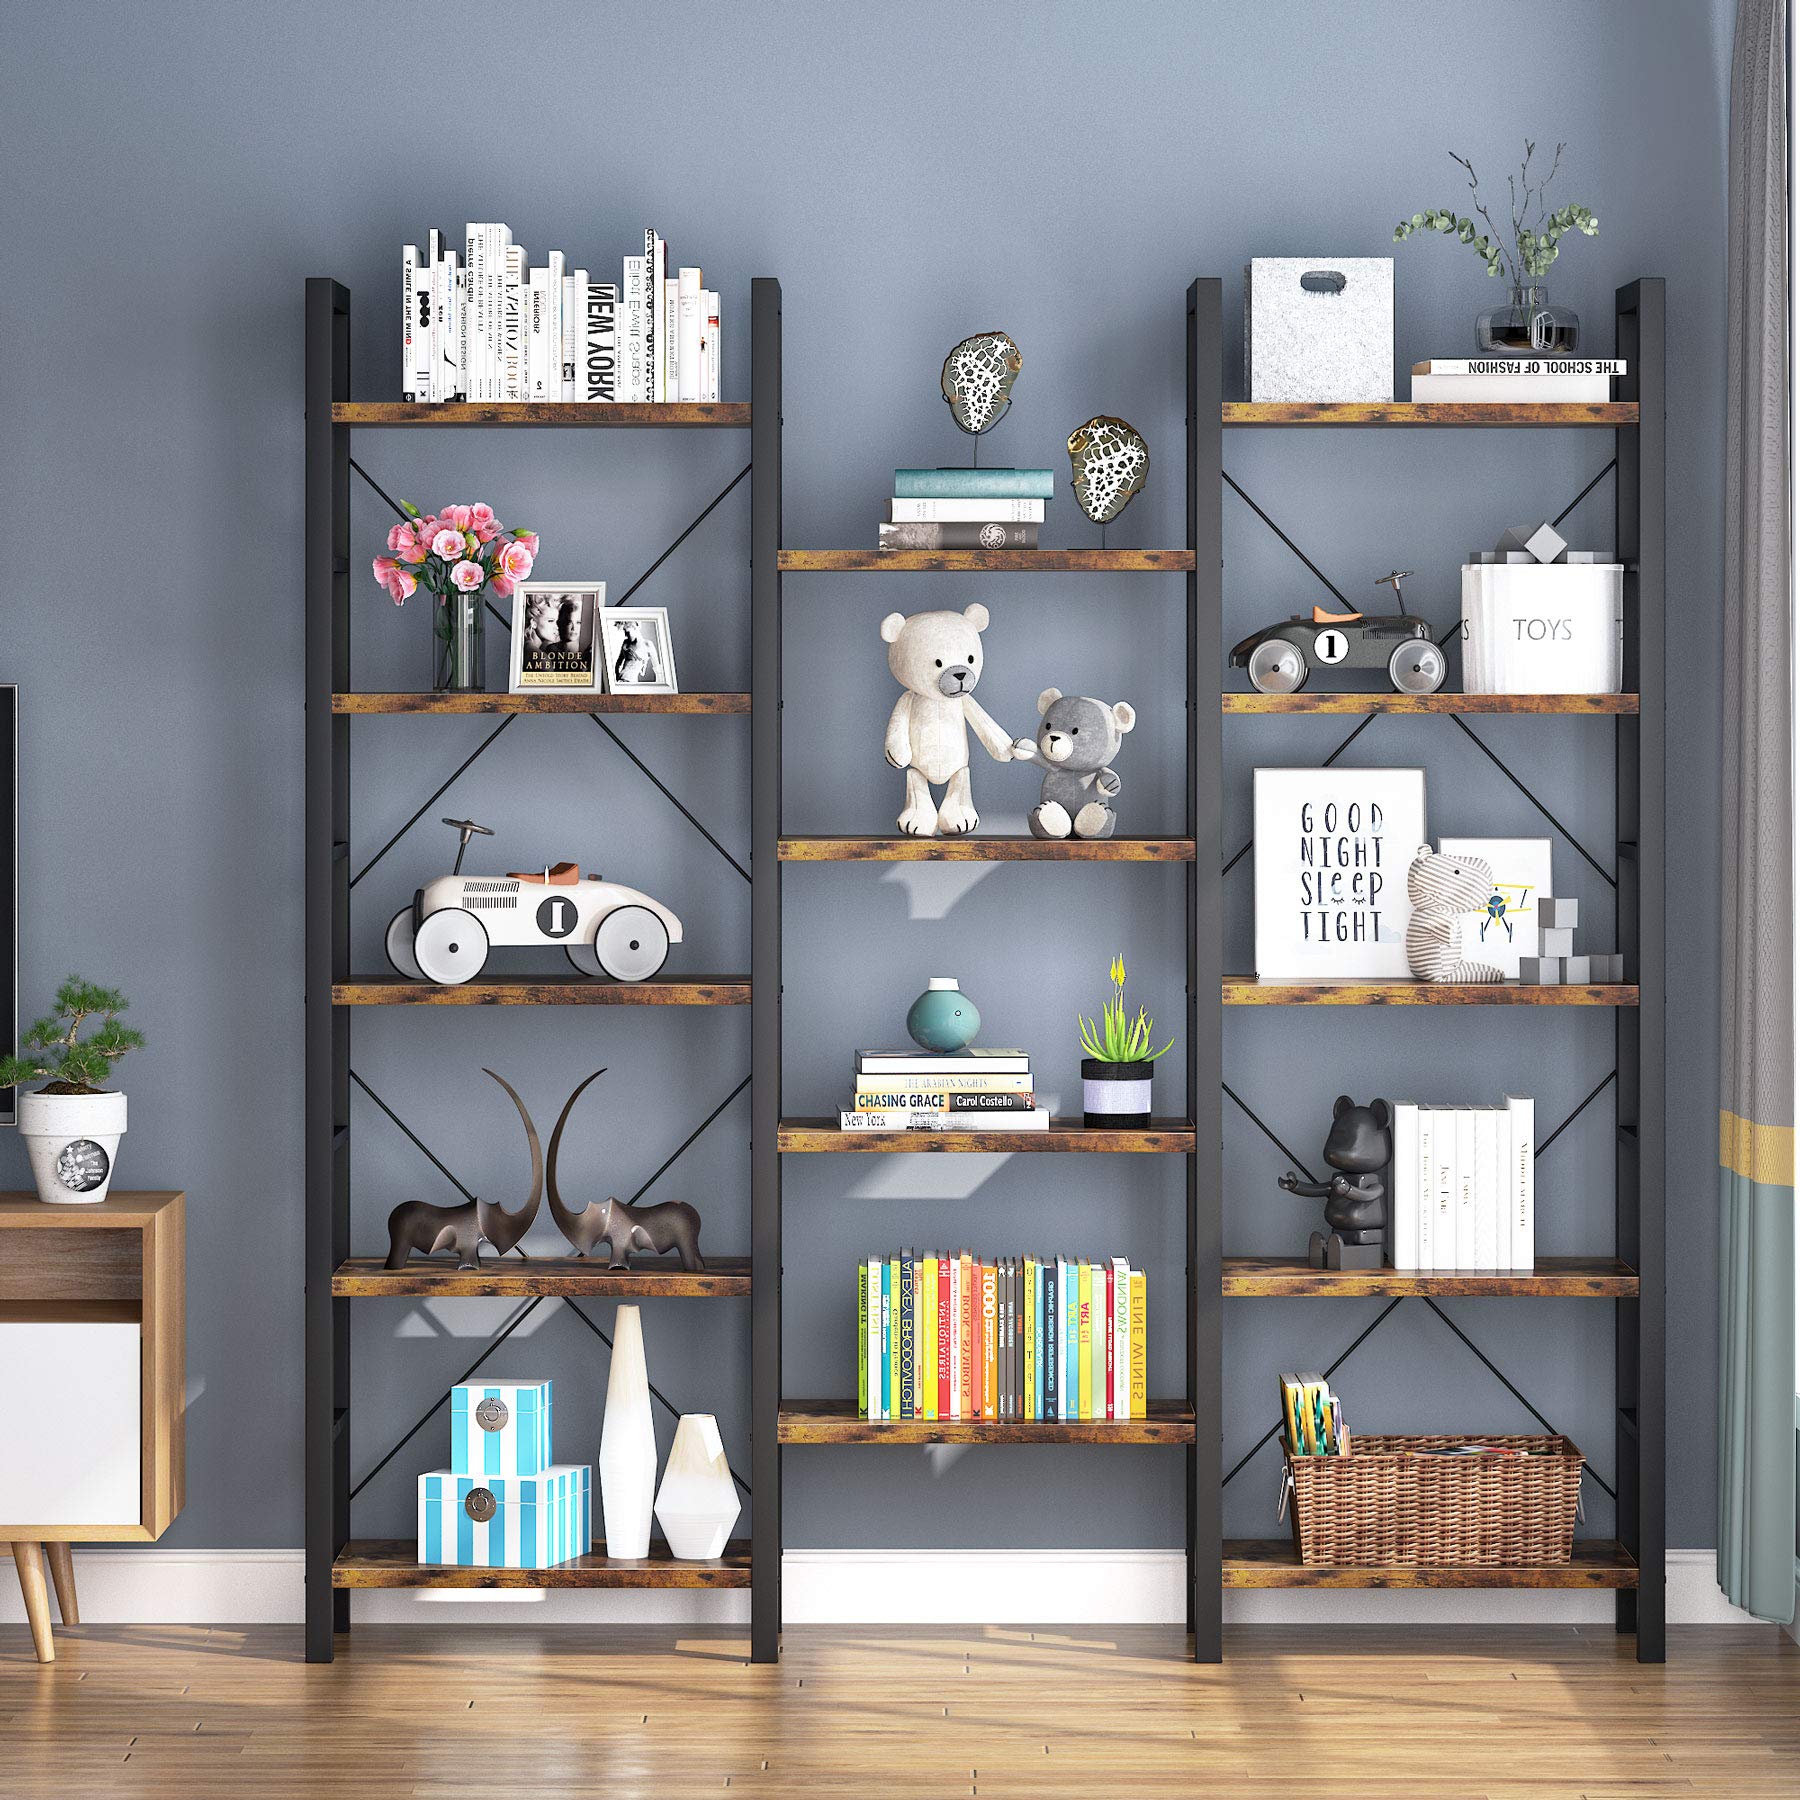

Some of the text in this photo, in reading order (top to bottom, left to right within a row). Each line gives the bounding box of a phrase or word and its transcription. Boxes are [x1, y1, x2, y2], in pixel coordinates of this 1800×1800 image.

[1468, 361, 1620, 374] THE SCHOOL OF FASHION
[1512, 619, 1572, 641] TOYS
[1325, 635, 1337, 658] 1
[532, 652, 583, 660] BLONDE
[526, 661, 588, 670] AMBITION
[1301, 802, 1383, 833] GOOD
[1301, 837, 1383, 868] NIGHT
[1300, 911, 1382, 942] TIGHT
[905, 1079, 988, 1088] THE ARABIAN NIGHTS
[858, 1094, 945, 1108] CHASING GRACE
[956, 1095, 978, 1107] Carol
[979, 1095, 1013, 1107] Costello
[844, 1112, 886, 1126] New York
